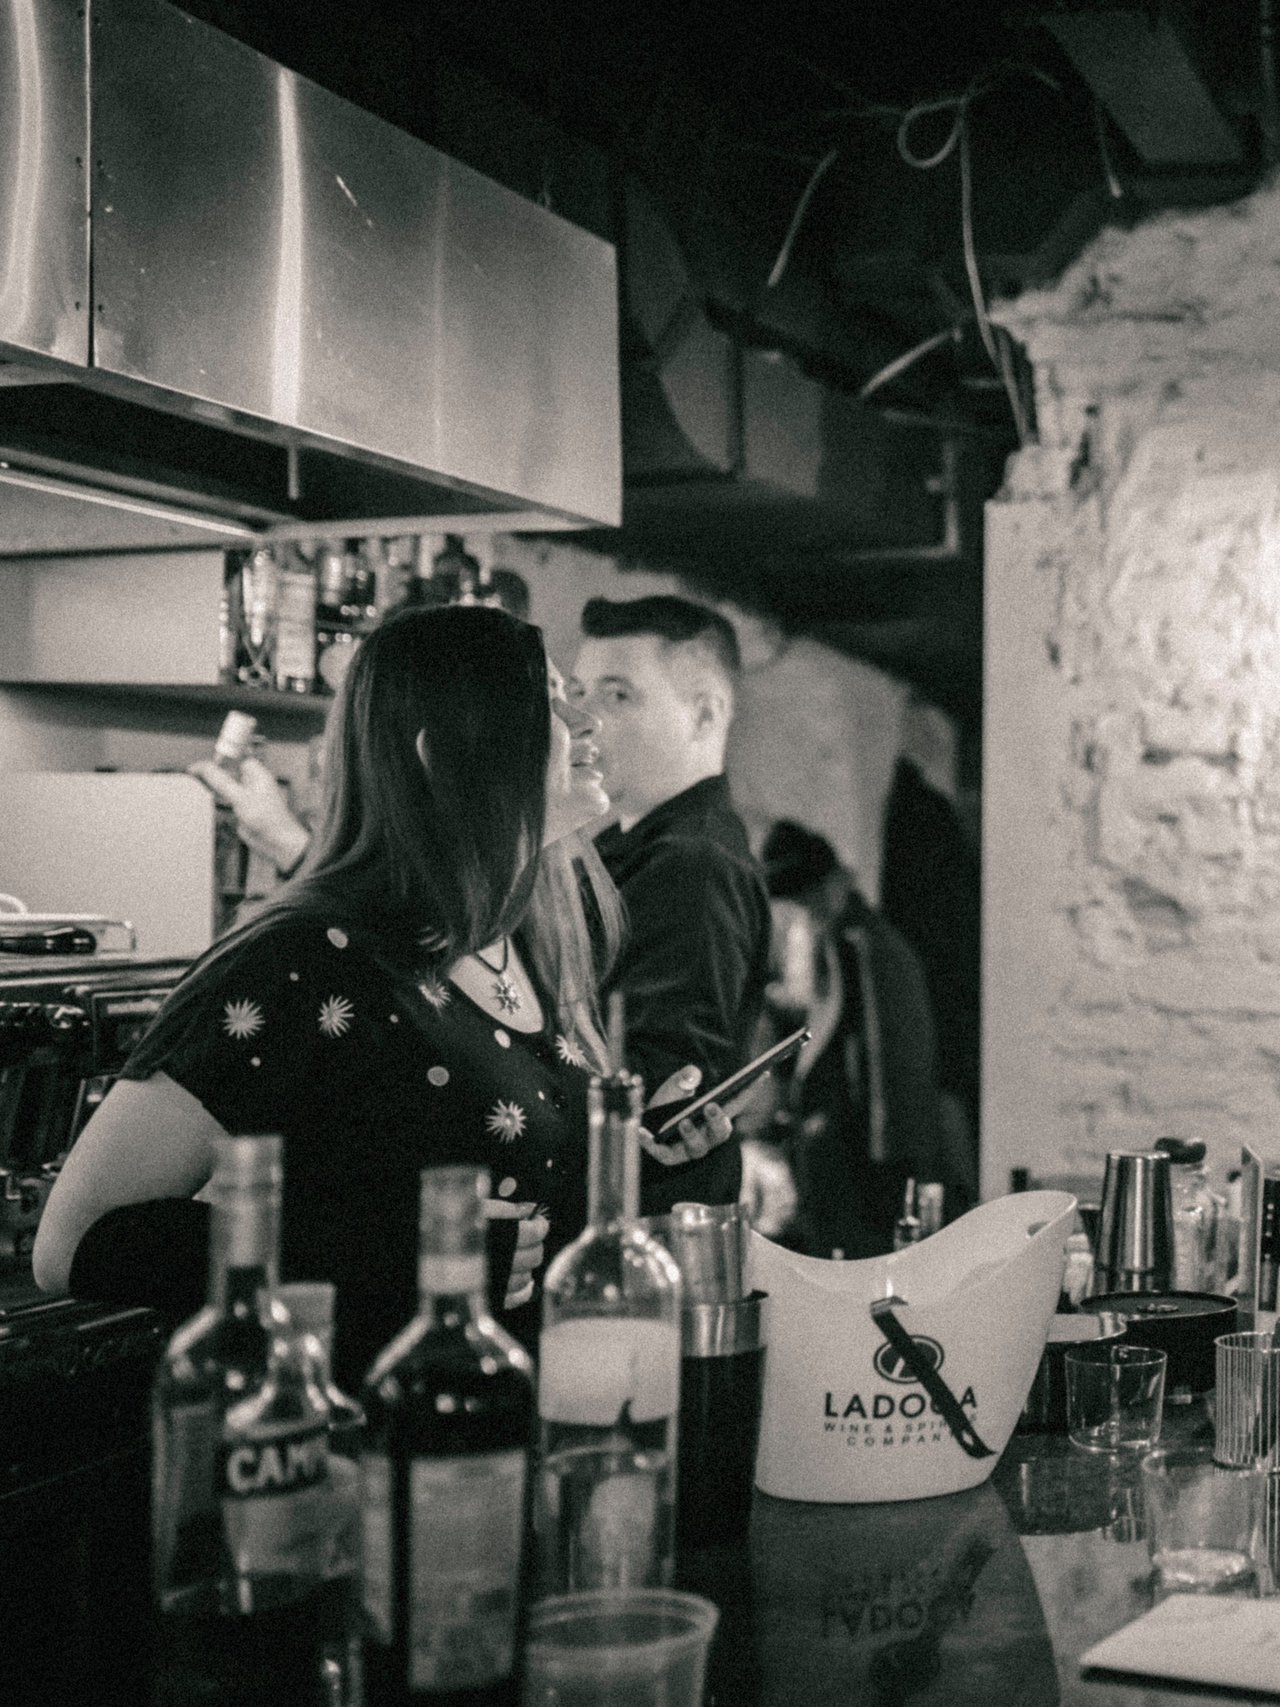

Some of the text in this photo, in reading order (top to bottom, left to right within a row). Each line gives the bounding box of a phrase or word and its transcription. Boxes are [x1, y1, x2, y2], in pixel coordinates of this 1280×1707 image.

[824, 1421, 873, 1434] WINE
[905, 1413, 977, 1433] SPIRS
[847, 1431, 953, 1447] COMPAN
